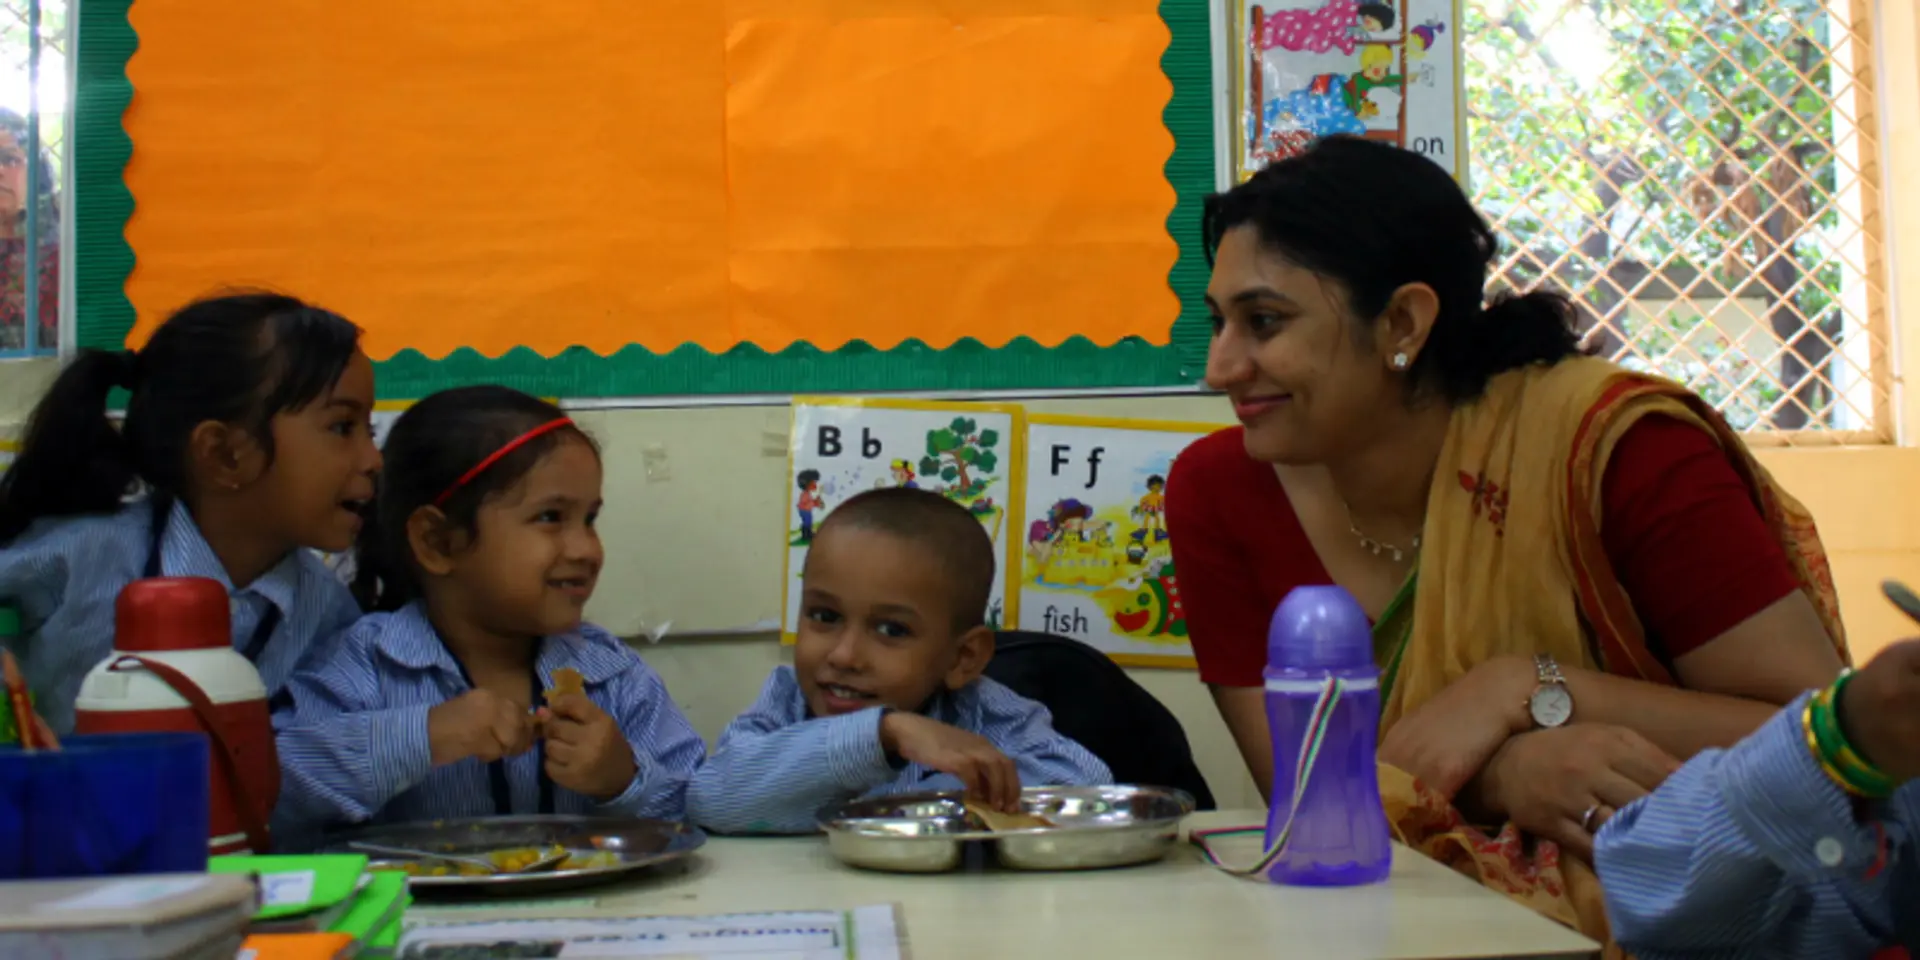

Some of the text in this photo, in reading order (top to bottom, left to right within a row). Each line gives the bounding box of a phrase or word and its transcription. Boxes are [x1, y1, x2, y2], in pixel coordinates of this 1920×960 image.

[1413, 136, 1445, 155] on
[817, 426, 883, 458] B b
[1050, 445, 1105, 489] F f
[1043, 605, 1089, 634] fish
